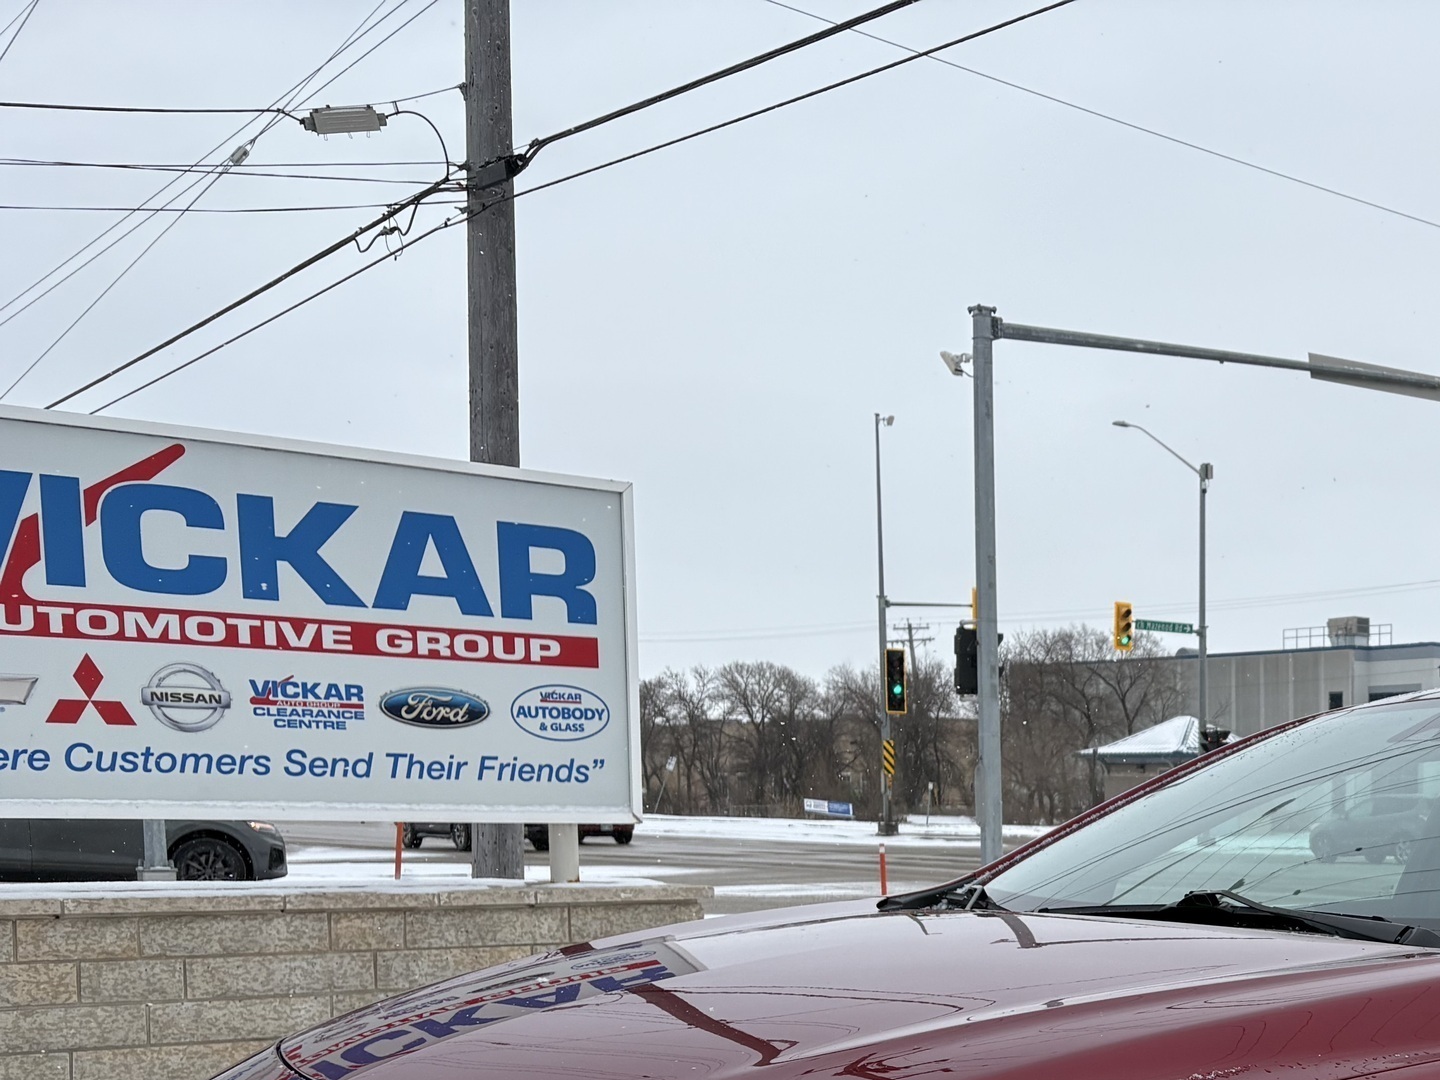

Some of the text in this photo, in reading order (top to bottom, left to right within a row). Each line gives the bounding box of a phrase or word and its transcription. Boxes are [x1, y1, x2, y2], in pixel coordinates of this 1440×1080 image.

[0, 469, 598, 626] ICKAR
[0, 603, 562, 662] UTOMOTIVE GROUP
[150, 690, 223, 706] NISSAN
[249, 678, 364, 702] VICKAR
[540, 691, 582, 701] VICKAR
[277, 700, 341, 709] AUTO GROUP
[401, 692, 470, 723] Ford
[253, 706, 365, 721] CLEARANCE
[516, 705, 606, 721] AUTOBODY
[273, 718, 347, 731] CENTRE
[539, 721, 585, 733] & GLASS
[64, 742, 271, 777] Customers
[284, 749, 374, 778] Send
[386, 752, 469, 781] Their
